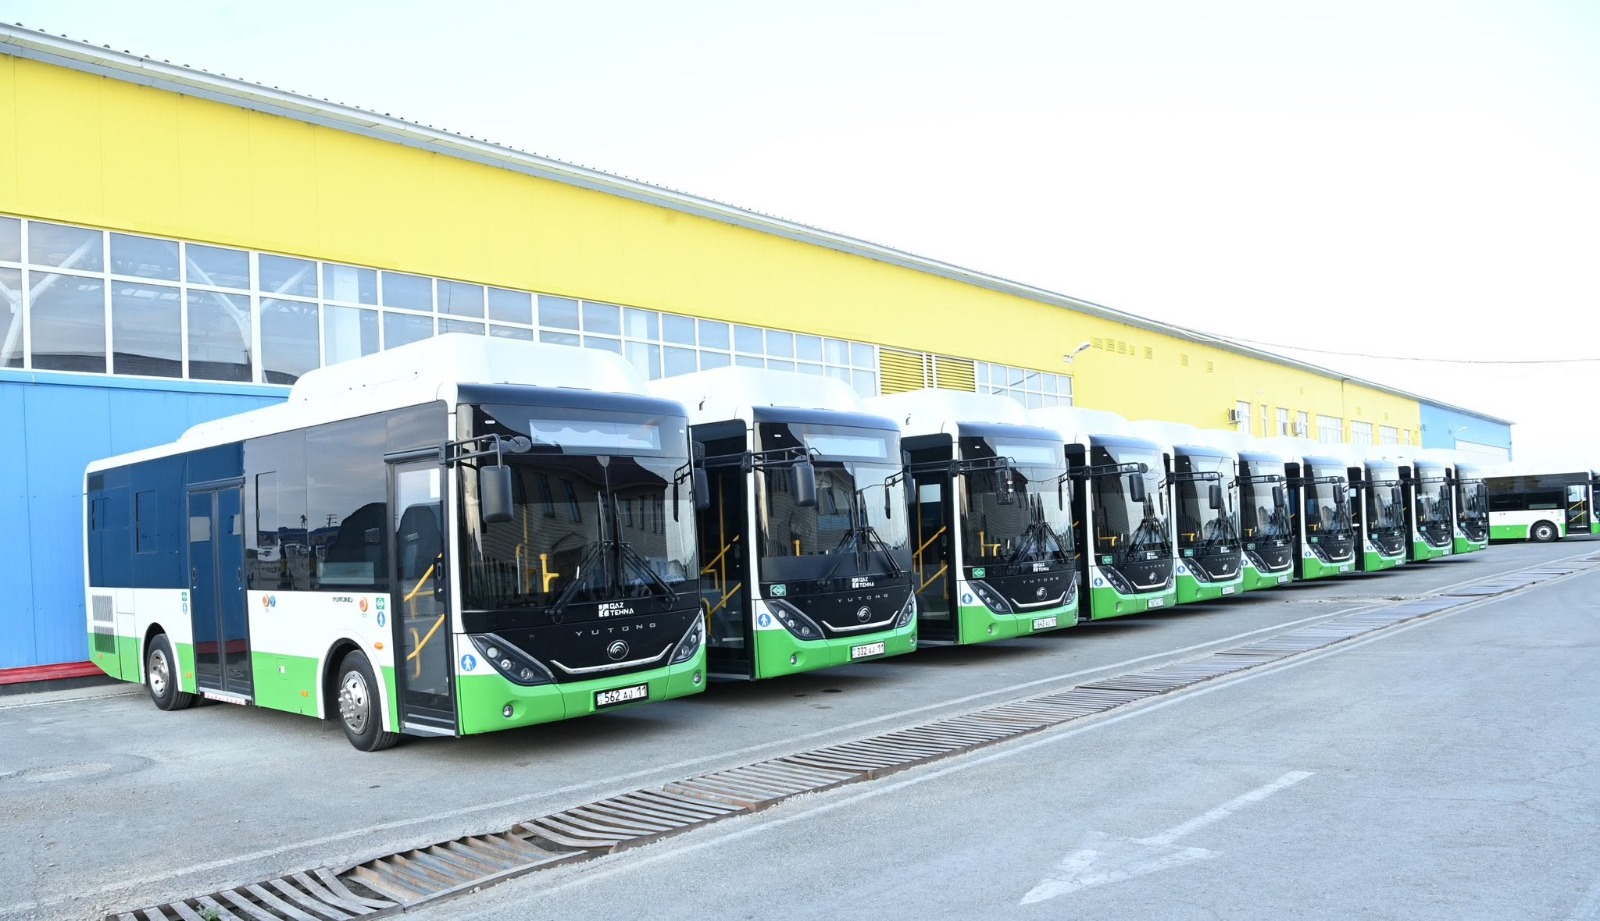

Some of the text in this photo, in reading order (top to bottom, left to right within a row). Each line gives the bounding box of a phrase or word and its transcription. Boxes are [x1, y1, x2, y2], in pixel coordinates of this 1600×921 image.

[837, 593, 889, 604] YUTONG
[609, 602, 624, 610] QAZ
[609, 608, 635, 617] TEHNA
[575, 622, 657, 637] YUTONG
[604, 685, 647, 703] 562 AJ 11
